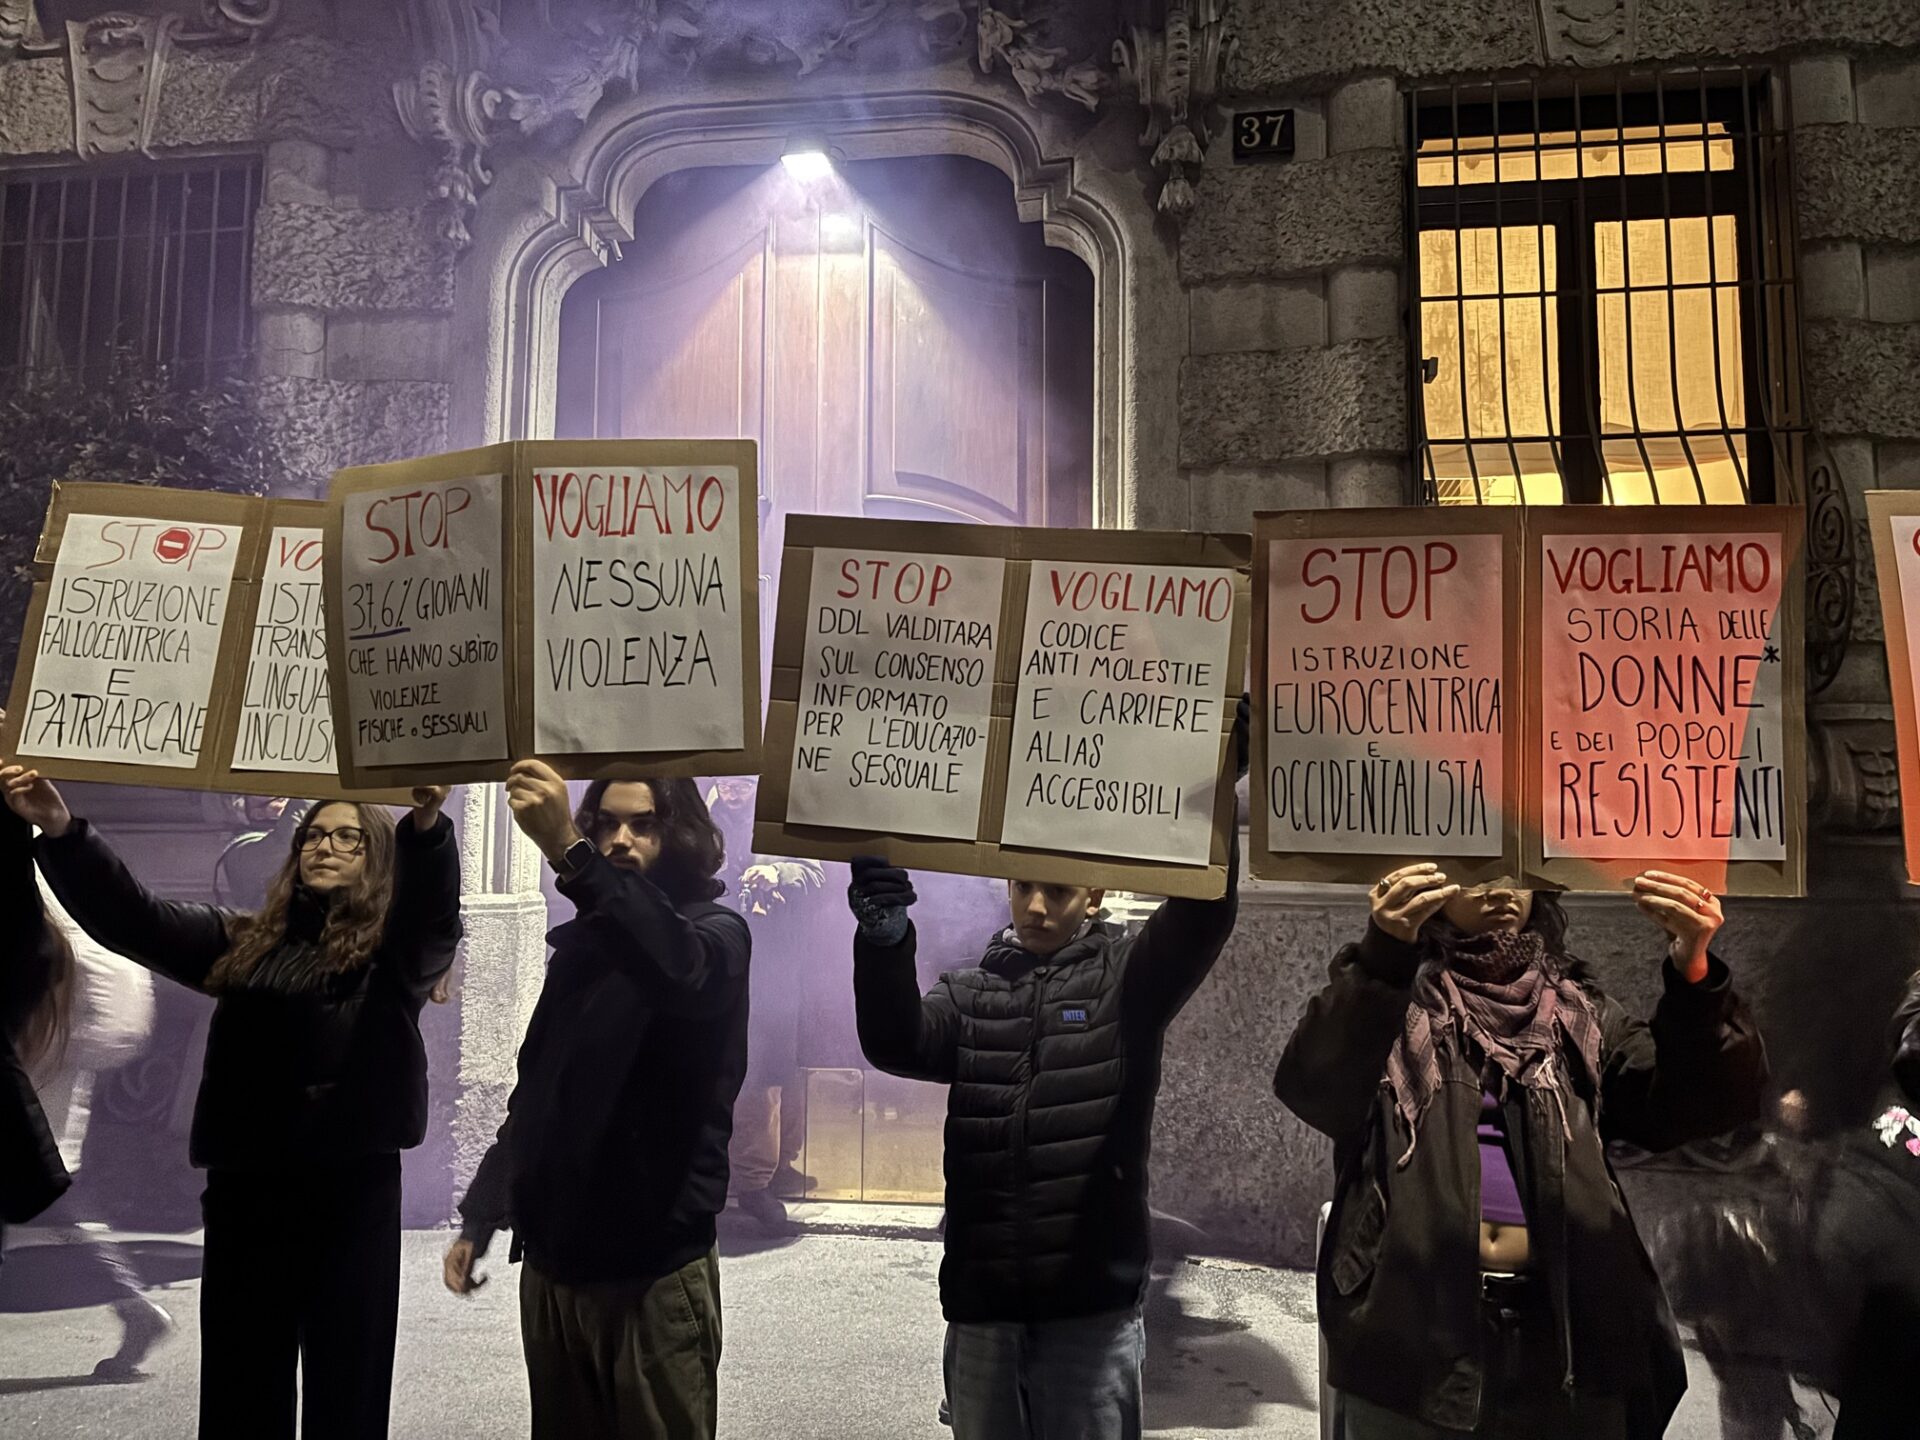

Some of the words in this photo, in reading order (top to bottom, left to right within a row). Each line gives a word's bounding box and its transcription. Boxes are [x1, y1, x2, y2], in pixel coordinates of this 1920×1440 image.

[1241, 114, 1285, 147] 37
[365, 487, 471, 563] STOP
[534, 473, 724, 541] VOGLIAMO
[86, 521, 227, 571] STOP
[1547, 542, 1771, 594] VOGLIAMO
[58, 577, 220, 625] ISTRUZIONE
[349, 577, 413, 633] 37,6%
[416, 567, 489, 621] GIOVANI
[551, 553, 726, 614] NESSUNA
[837, 559, 952, 606] STOP
[1050, 569, 1233, 622] VOGLIAMO
[1300, 542, 1458, 624] STOP
[40, 615, 190, 663] FALLOCENTRICA
[818, 606, 869, 635] DDL
[886, 613, 993, 650] VALDITARA
[1040, 620, 1129, 651] CODICE
[1567, 607, 1699, 643] STORIA
[1719, 609, 1772, 640] DELLE
[348, 647, 378, 676] CHE
[386, 648, 442, 673] HANNO
[547, 629, 717, 691] VIOLENZA
[820, 646, 860, 678] SUL
[875, 651, 985, 688] CONSENSO
[1025, 650, 1079, 677] ANTI
[1090, 657, 1212, 687] MOLESTIE
[1292, 644, 1470, 671] ISTRUZIONE
[107, 668, 135, 695] E
[369, 683, 441, 709] VIOLENZE
[813, 683, 948, 720] INFORMATO
[23, 689, 208, 755] PATRIARCALE
[358, 719, 405, 745] FISICHE
[422, 711, 488, 738] SESSUALI
[1033, 688, 1054, 719] E
[1080, 689, 1214, 733] CARRIERE
[1274, 677, 1502, 736] EUROCENTRICA
[804, 711, 844, 737] PER
[868, 715, 986, 756] L'EDUCAZIO-
[1026, 731, 1104, 769] ALIAS
[1368, 741, 1381, 758] E
[1551, 731, 1562, 751] E
[1577, 732, 1613, 753] DEI
[1637, 722, 1763, 761] POPOLI
[798, 746, 832, 772] NE
[849, 750, 963, 793] SESSUALE
[1026, 773, 1181, 820] ACCESSIBILI
[1271, 759, 1488, 838] OCCIDENTALISTA
[1560, 762, 1785, 846] RESISTENTI
[1062, 1010, 1086, 1021] INTER
